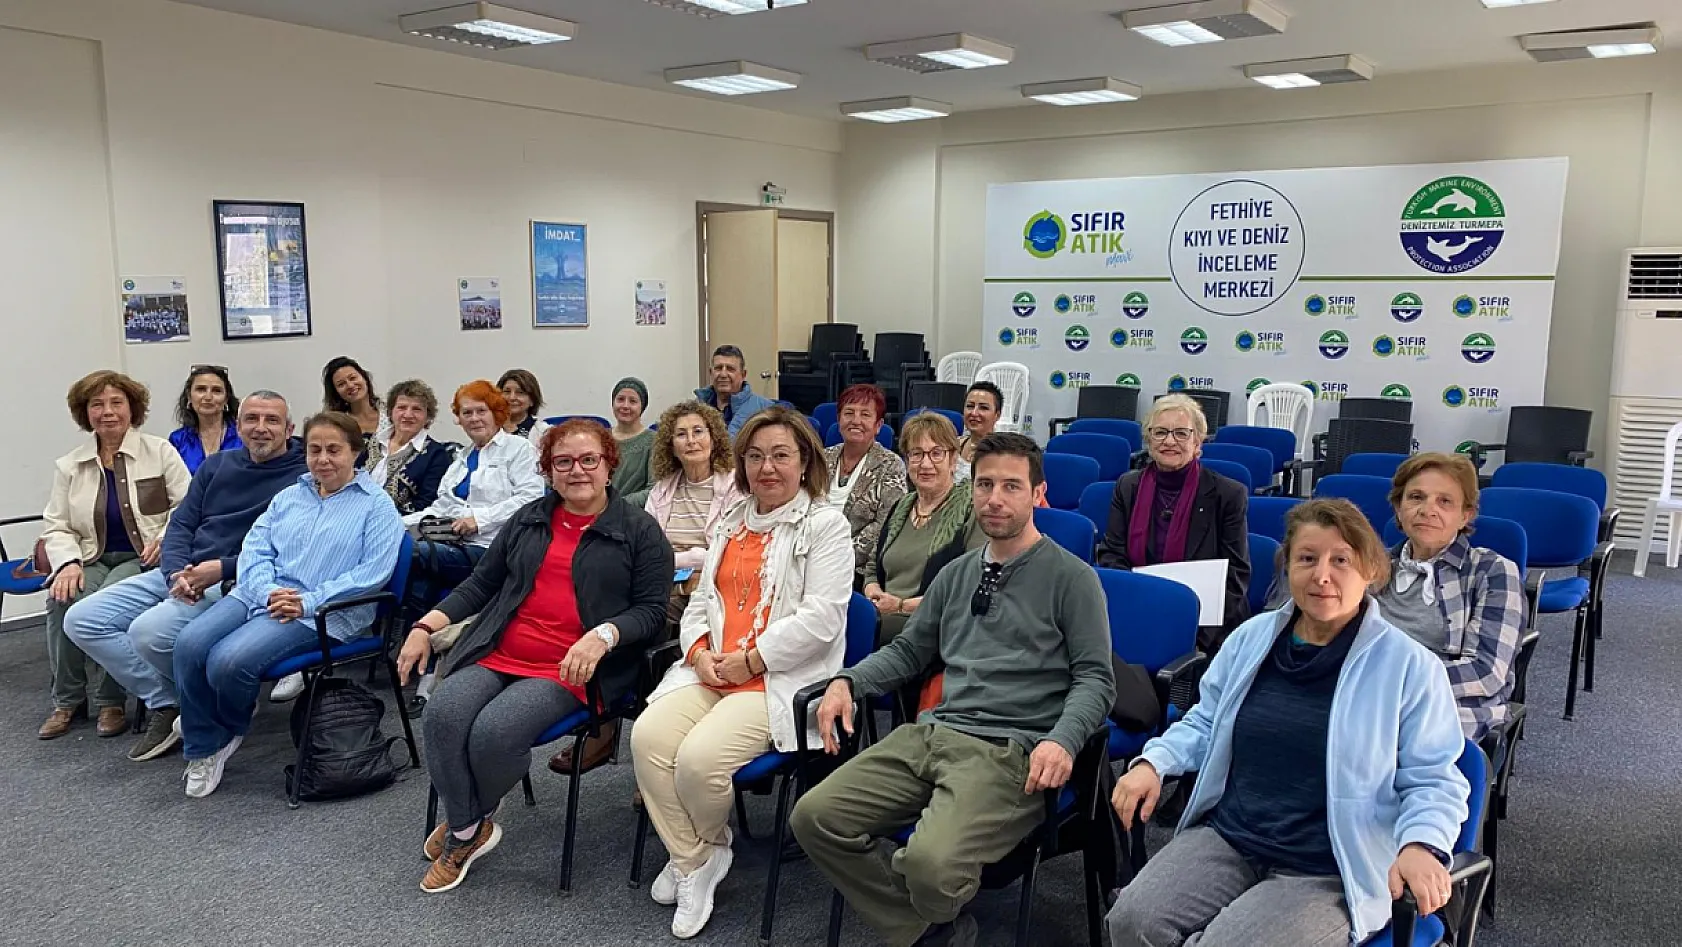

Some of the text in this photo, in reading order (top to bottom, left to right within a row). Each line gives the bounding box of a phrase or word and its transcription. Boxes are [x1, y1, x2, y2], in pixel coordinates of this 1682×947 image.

[1404, 180, 1502, 219] TURKISH MARINE ENVIRONMENT
[1211, 198, 1273, 220] FETHİYE
[1071, 212, 1125, 232] SIFIR
[1401, 219, 1503, 230] DENİZTEMİZ TURMEPA
[1184, 223, 1290, 247] KIYI VE DENİZ
[1070, 232, 1125, 254] ATIK
[1198, 253, 1279, 272] İNCELEME
[1406, 245, 1494, 273] PROTECTION ASSOCIATION
[1203, 277, 1274, 298] MERKEZİ
[1072, 295, 1096, 303] SIFIR
[1328, 296, 1356, 305] SIFIR
[1479, 296, 1510, 306] SIFIR
[1072, 303, 1095, 312] ATIK
[1328, 305, 1355, 315] ATIK
[1478, 307, 1509, 317] ATIK
[1016, 328, 1038, 337] SIFIR
[1130, 329, 1154, 338] SIFIR
[1257, 332, 1284, 342] SIFIR
[1016, 336, 1037, 345] ATIK
[1130, 338, 1153, 347] ATIK
[1397, 337, 1426, 346] SIFIR
[1257, 341, 1284, 351] ATIK
[1397, 346, 1425, 356] ATIK
[1068, 372, 1091, 380] SIFIR
[1189, 377, 1214, 386] SIFIR
[1321, 382, 1349, 392] SIFIR
[1468, 387, 1499, 398] SIFIR
[1468, 398, 1498, 408] ATIK
